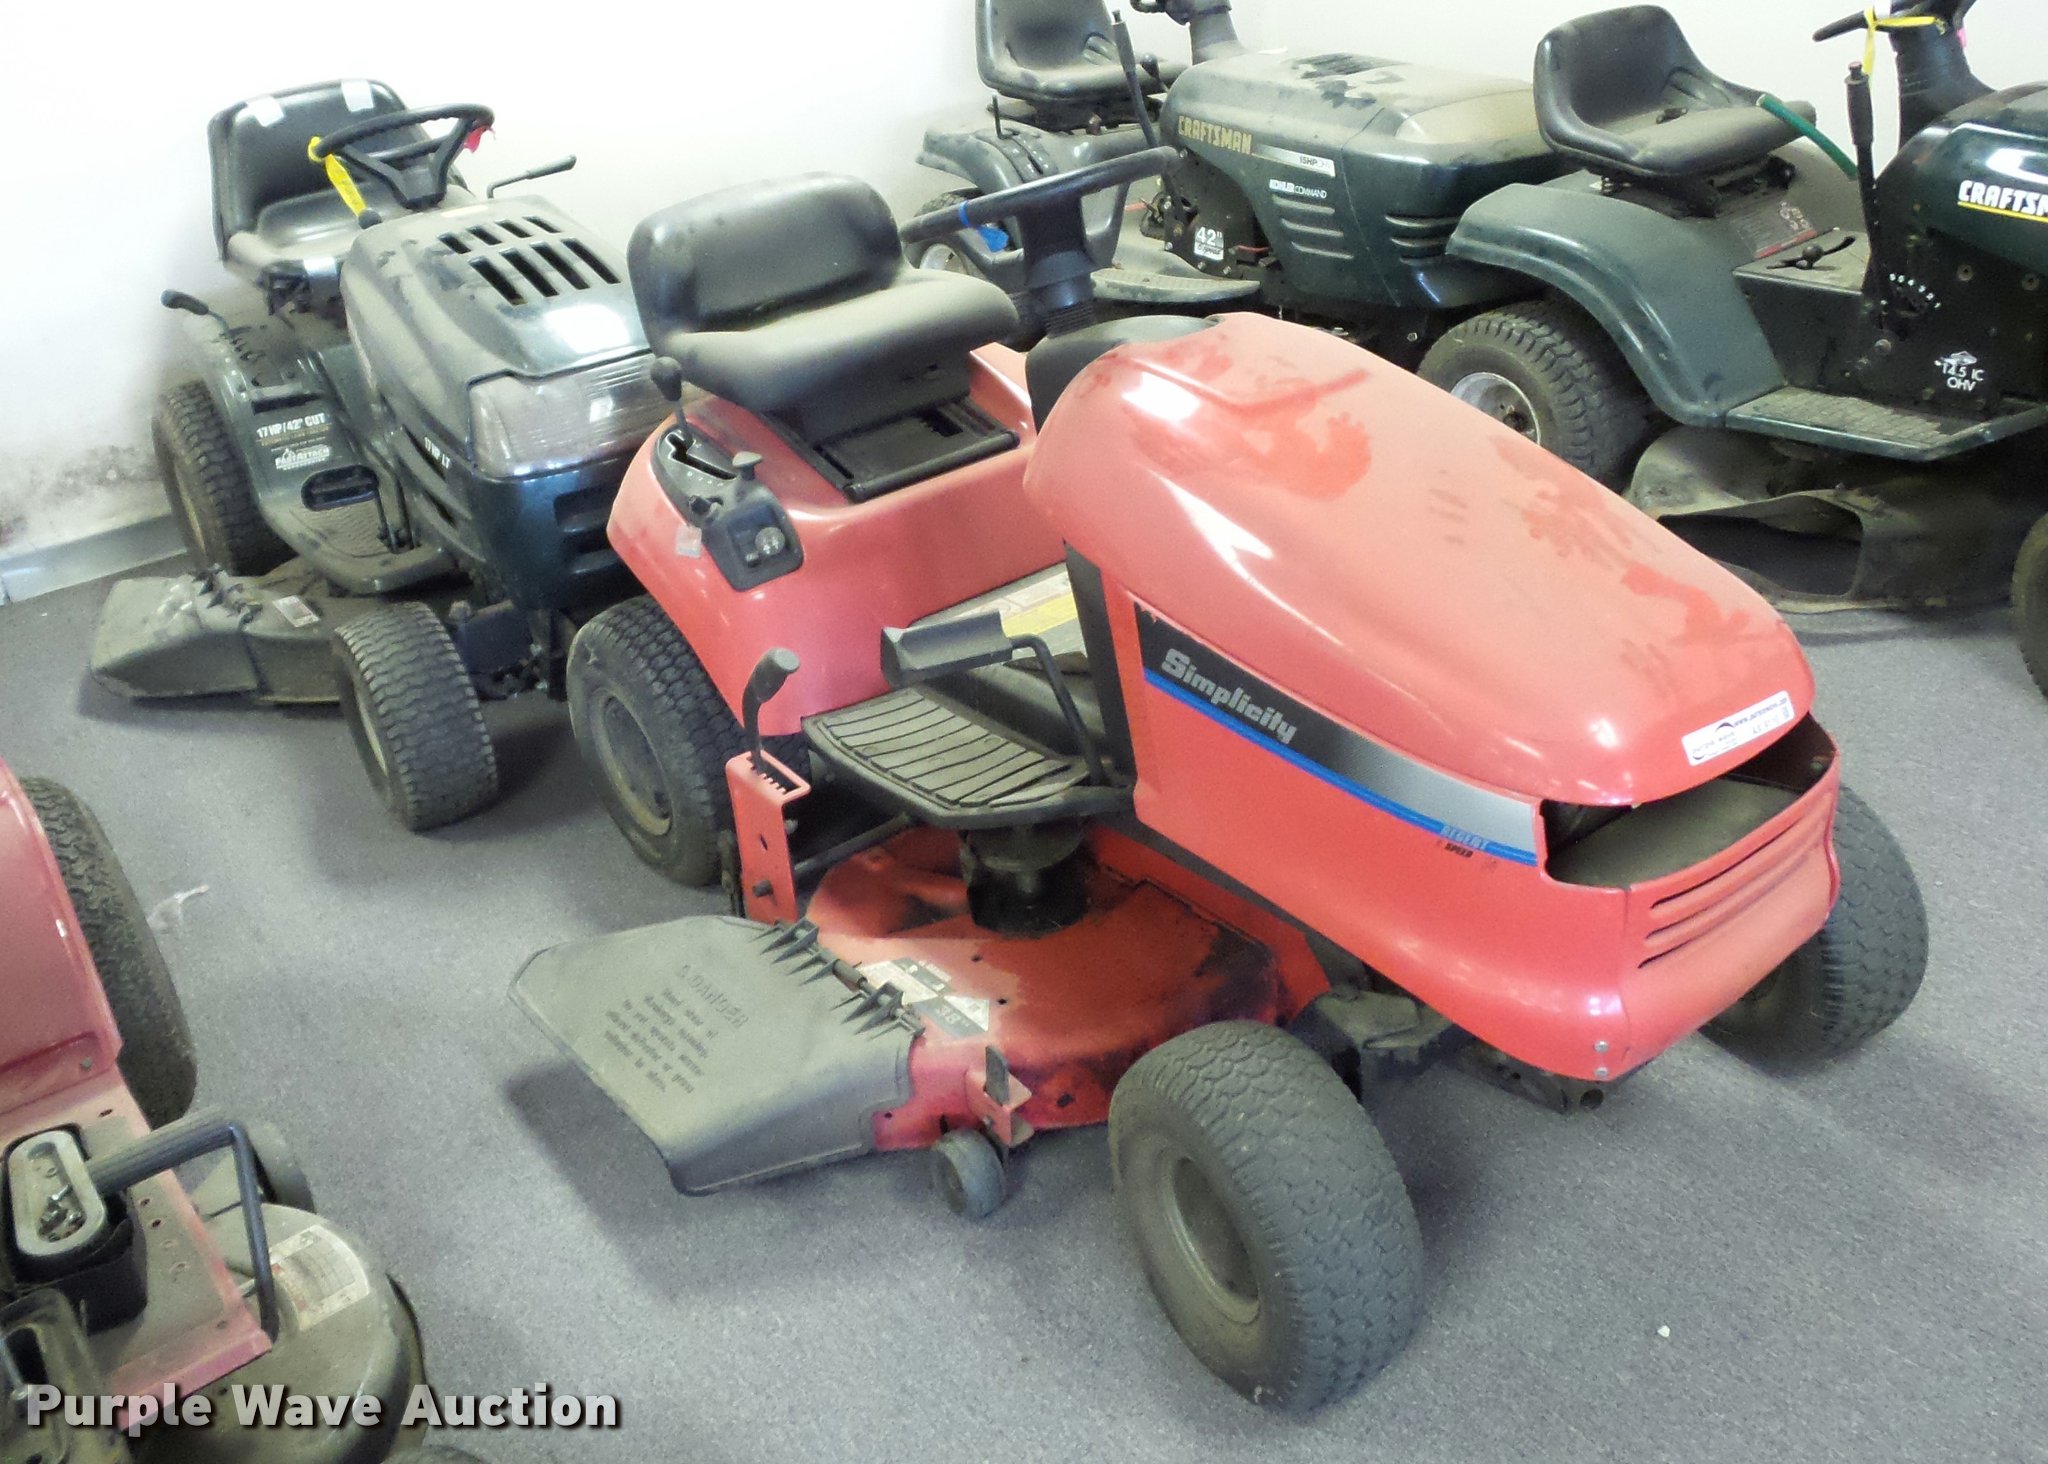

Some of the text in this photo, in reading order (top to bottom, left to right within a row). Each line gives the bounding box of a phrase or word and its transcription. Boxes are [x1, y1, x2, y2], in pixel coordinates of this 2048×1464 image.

[1178, 115, 1252, 155] CRAFTSMAN
[1295, 185, 1328, 199] COMMAND
[1947, 377, 1976, 391] OHV
[304, 412, 326, 427] CUT
[1161, 648, 1298, 745] Simplicity
